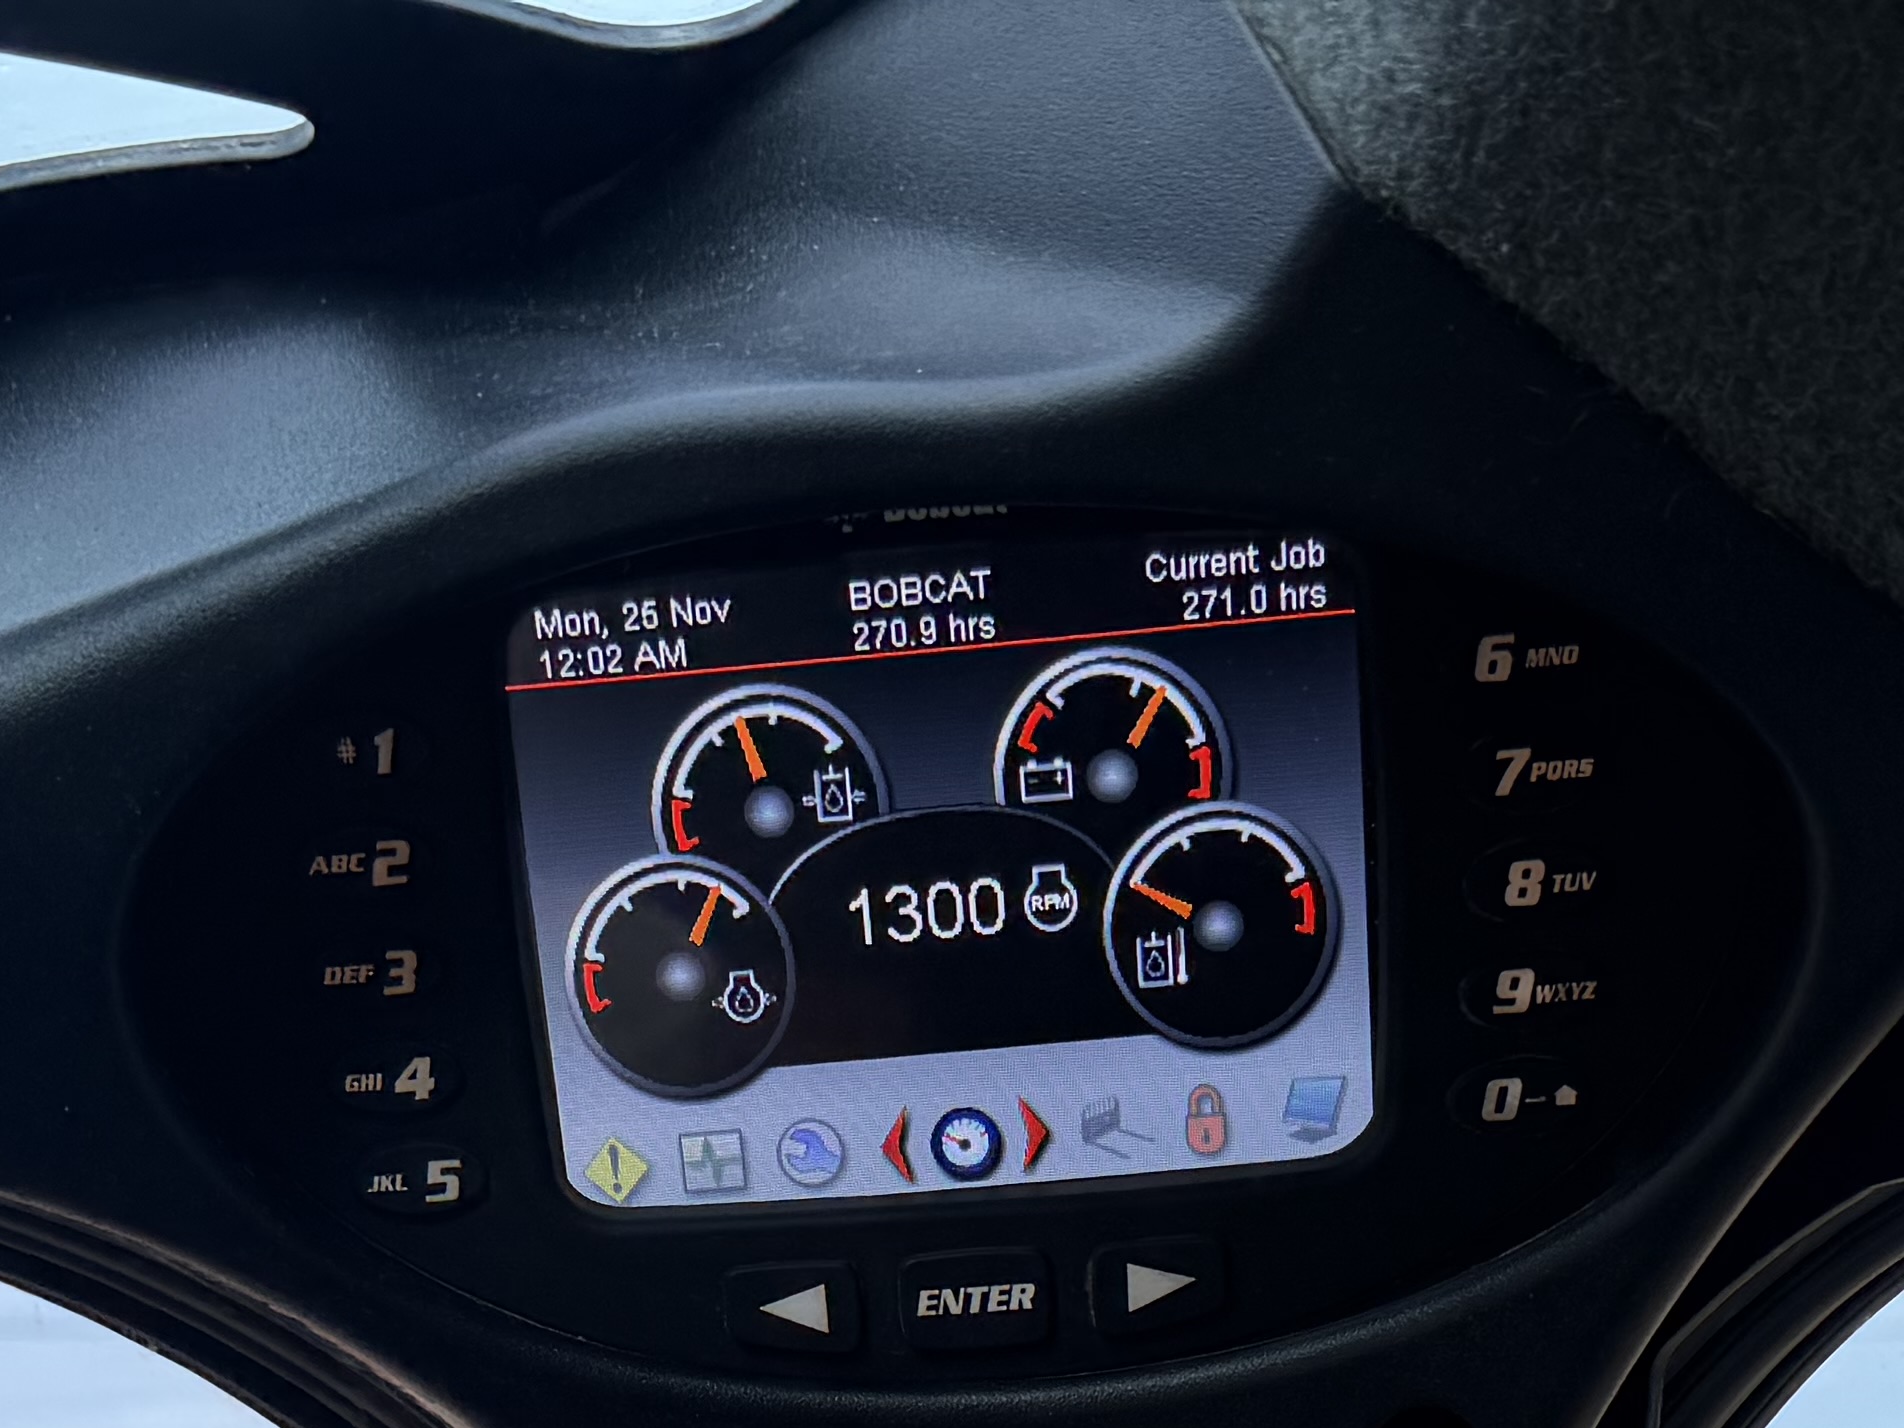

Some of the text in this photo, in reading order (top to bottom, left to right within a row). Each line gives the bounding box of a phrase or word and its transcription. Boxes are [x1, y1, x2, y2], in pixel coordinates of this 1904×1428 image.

[1145, 537, 1326, 583] Current Job
[848, 567, 992, 611] BOBCAT
[1182, 582, 1327, 621] 271.0 hrs
[533, 607, 609, 640] Mon,
[669, 595, 732, 628] Nov
[852, 613, 996, 651] 270.9 hrs
[539, 637, 688, 680] 12:02 AM
[1474, 632, 1580, 682] 6 MNO
[373, 728, 395, 775] 1
[1495, 747, 1532, 797] 7
[309, 839, 411, 887] ABC 2
[1504, 859, 1597, 906] 8 TUV
[848, 877, 1006, 946] 1300
[323, 949, 418, 996] DEF 3
[1492, 968, 1597, 1014] 9 WXYZ
[345, 1056, 435, 1101] GHI 4
[367, 1159, 462, 1203] JKL 5
[916, 1282, 1037, 1317] ENTER
